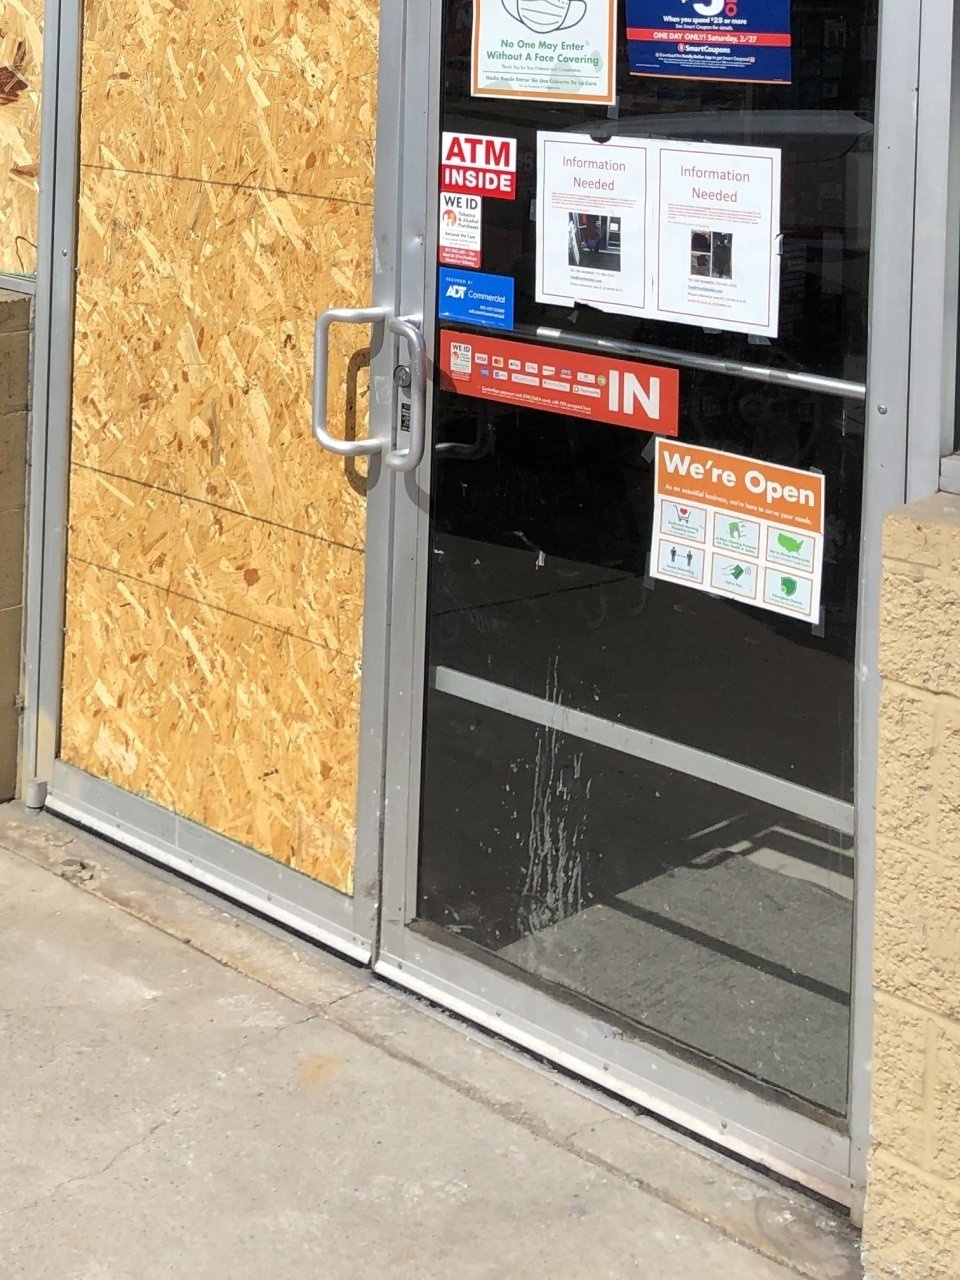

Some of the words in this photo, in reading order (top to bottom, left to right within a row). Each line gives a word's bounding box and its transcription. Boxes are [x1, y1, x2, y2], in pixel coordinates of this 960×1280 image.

[663, 15, 680, 23] When
[653, 31, 668, 39] ONE
[669, 32, 683, 40] DAY
[684, 32, 706, 41] ONLY!
[707, 34, 738, 44] Saturday,
[740, 35, 757, 43] 2/27
[501, 39, 514, 48] No
[517, 40, 536, 49] One
[538, 40, 558, 52] May
[561, 42, 585, 51] Enter
[487, 50, 522, 61] Without
[525, 52, 532, 61] A
[534, 52, 554, 63] Face
[557, 54, 599, 66] Covering
[445, 136, 510, 167] ATM
[562, 156, 626, 171] Information
[444, 168, 512, 192] INSIDE
[681, 165, 750, 183] Information
[573, 176, 615, 191] Needed
[692, 187, 737, 202] Needed
[444, 195, 462, 208] WE
[466, 198, 478, 210] ID
[445, 276, 466, 284] SECURED
[445, 284, 467, 299] ADT
[468, 290, 506, 304] Commercial
[608, 370, 660, 420] IN
[663, 451, 737, 487] We're
[744, 470, 815, 507] Open
[682, 487, 705, 498] essential
[705, 491, 728, 505] business,
[730, 498, 744, 507] we're
[745, 501, 757, 511] here
[765, 508, 779, 517] serve
[780, 512, 793, 520] your
[794, 514, 812, 525] needs.
